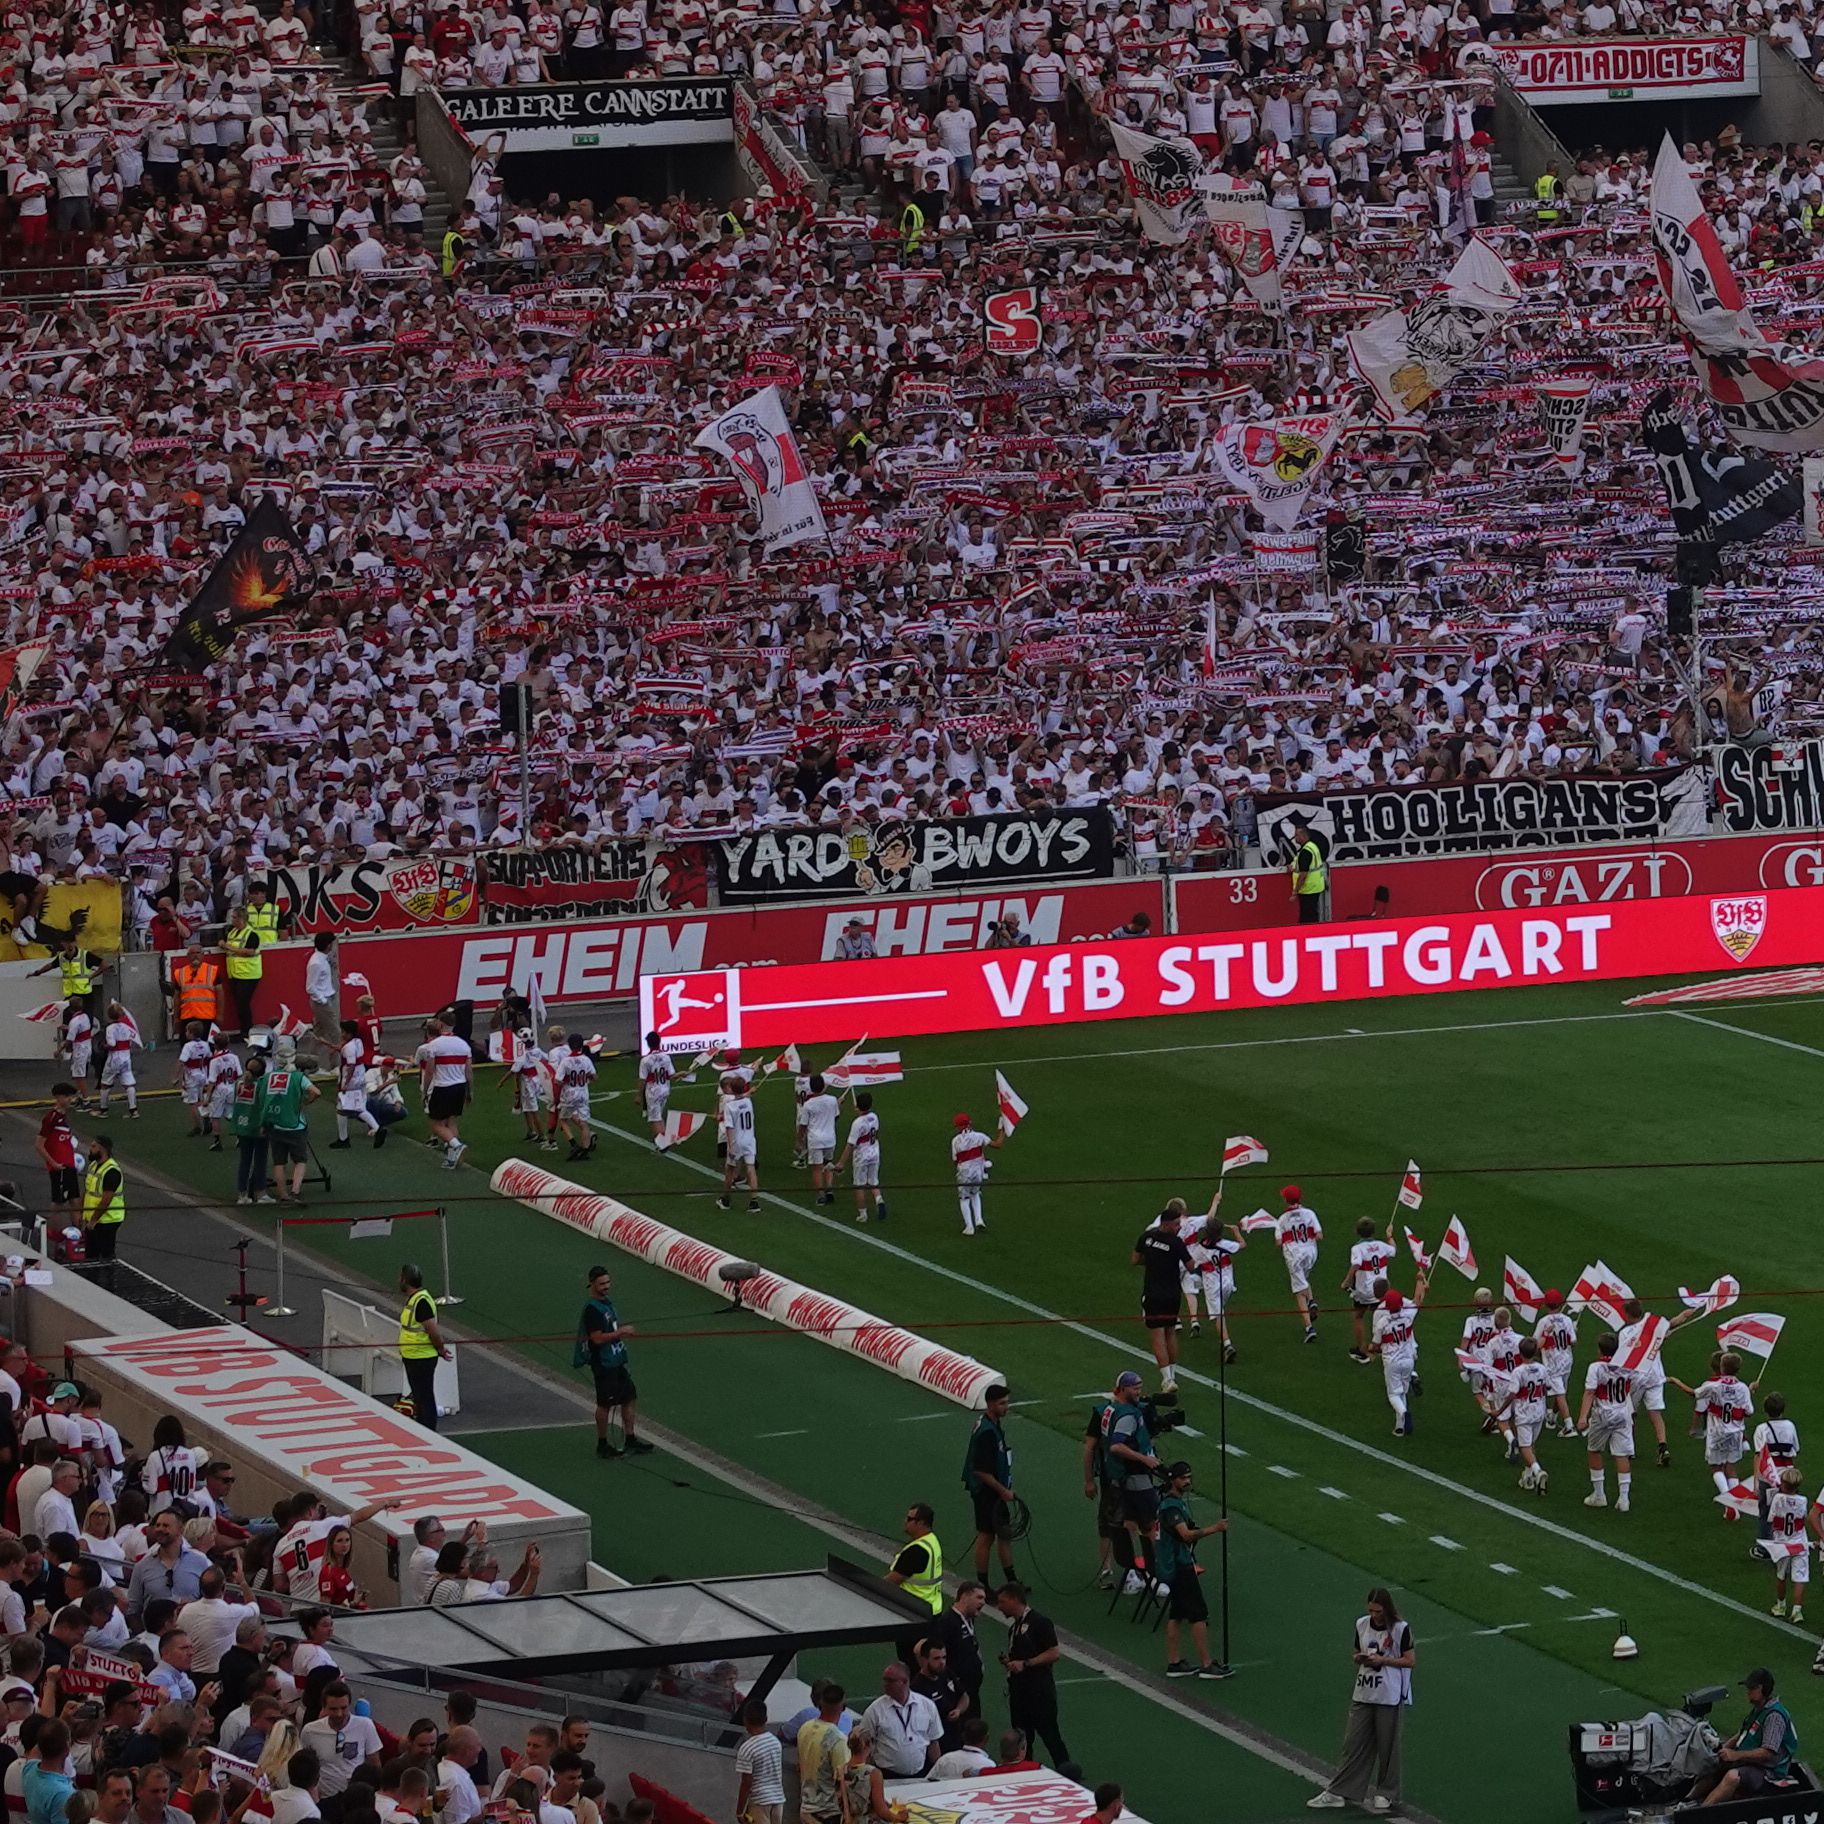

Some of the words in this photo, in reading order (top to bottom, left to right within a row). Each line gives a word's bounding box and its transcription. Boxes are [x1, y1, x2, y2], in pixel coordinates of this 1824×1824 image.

[447, 91, 580, 123] GALEERE
[583, 85, 728, 117] CANNSTATT
[1324, 779, 1660, 845] HOOLIGANS
[488, 838, 648, 888] SUPPORTERS
[720, 831, 850, 884] YARD
[923, 817, 1091, 873] BWOYS
[1228, 876, 1258, 904] 33
[454, 921, 709, 1004] EHEIM
[981, 951, 1126, 1018] VfB
[1157, 913, 1613, 1007] STUTTGART
[101, 1328, 279, 1380] VfB
[1606, 1376, 1627, 1404] 10
[174, 1374, 561, 1526] STUTTGART
[295, 1539, 310, 1572] 6
